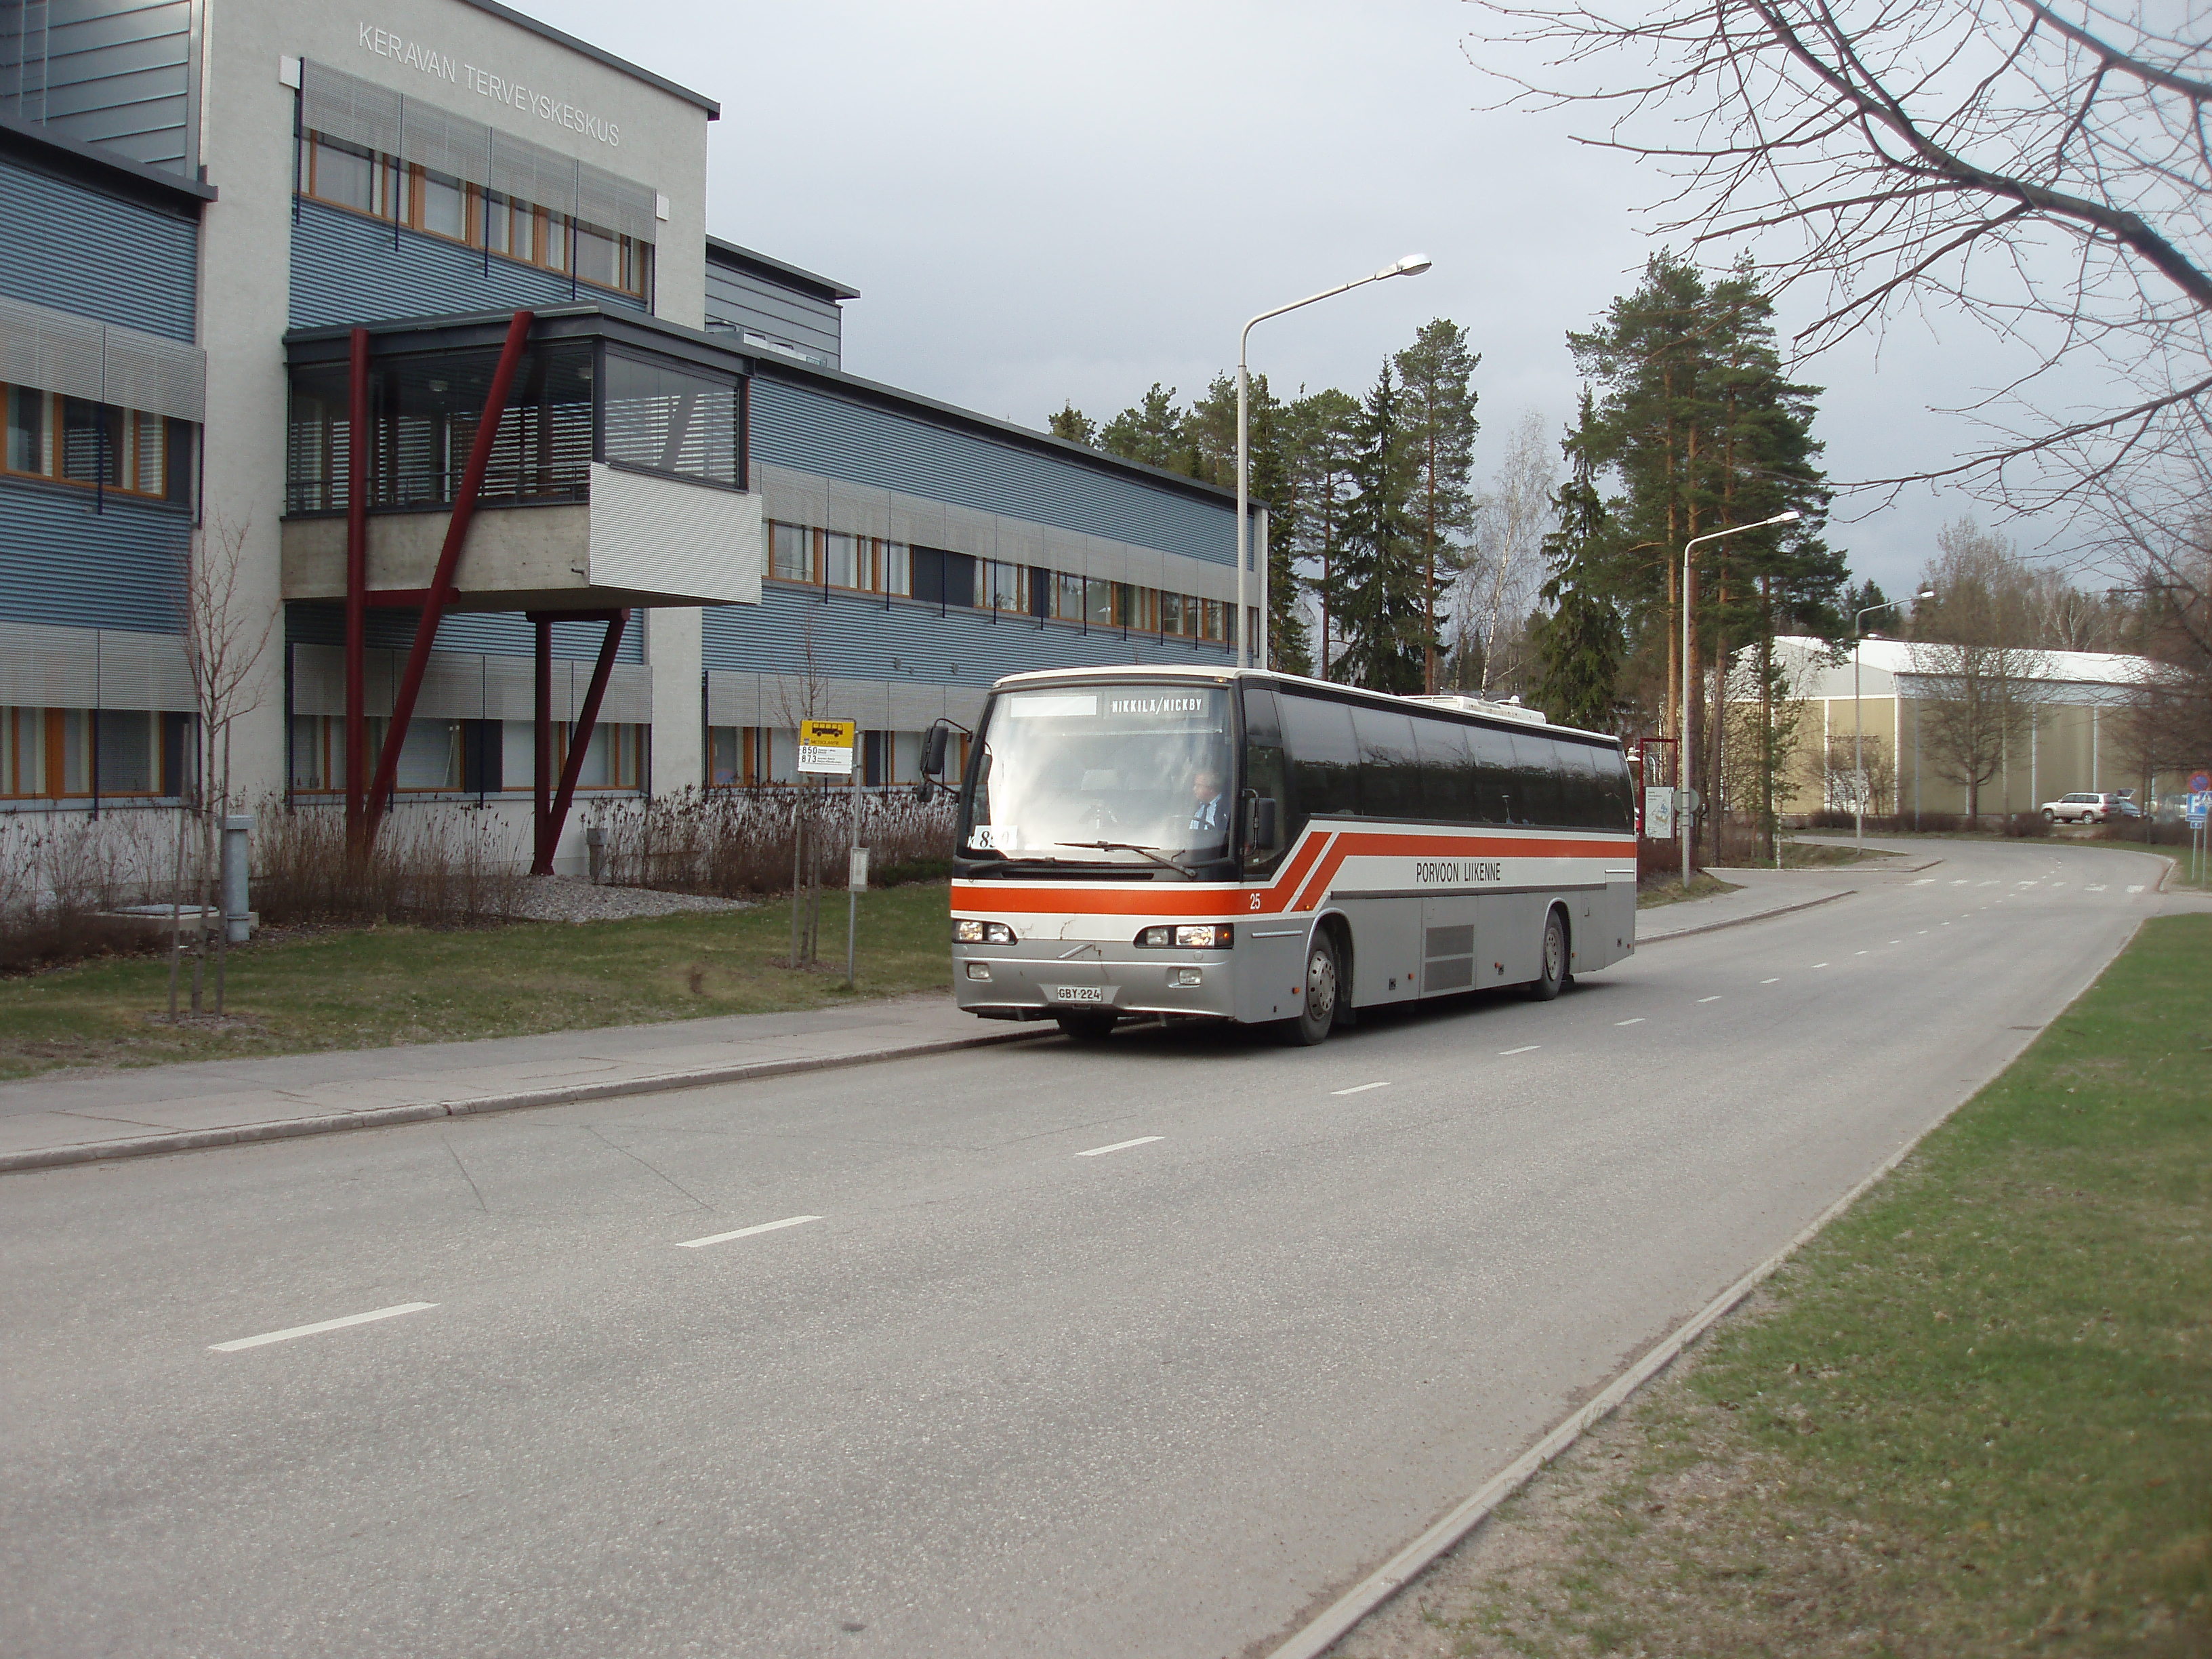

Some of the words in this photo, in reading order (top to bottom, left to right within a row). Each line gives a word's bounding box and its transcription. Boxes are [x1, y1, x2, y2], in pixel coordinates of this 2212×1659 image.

[359, 21, 456, 83] KERAVAN
[464, 64, 619, 147] TERVEYSKESKUS
[802, 746, 818, 754] 850
[801, 754, 817, 762] 873
[1416, 862, 1459, 882] PORVOON
[1464, 862, 1500, 882] LIIKENNE
[1250, 893, 1261, 909] 25
[1059, 988, 1100, 999] GBY-224
